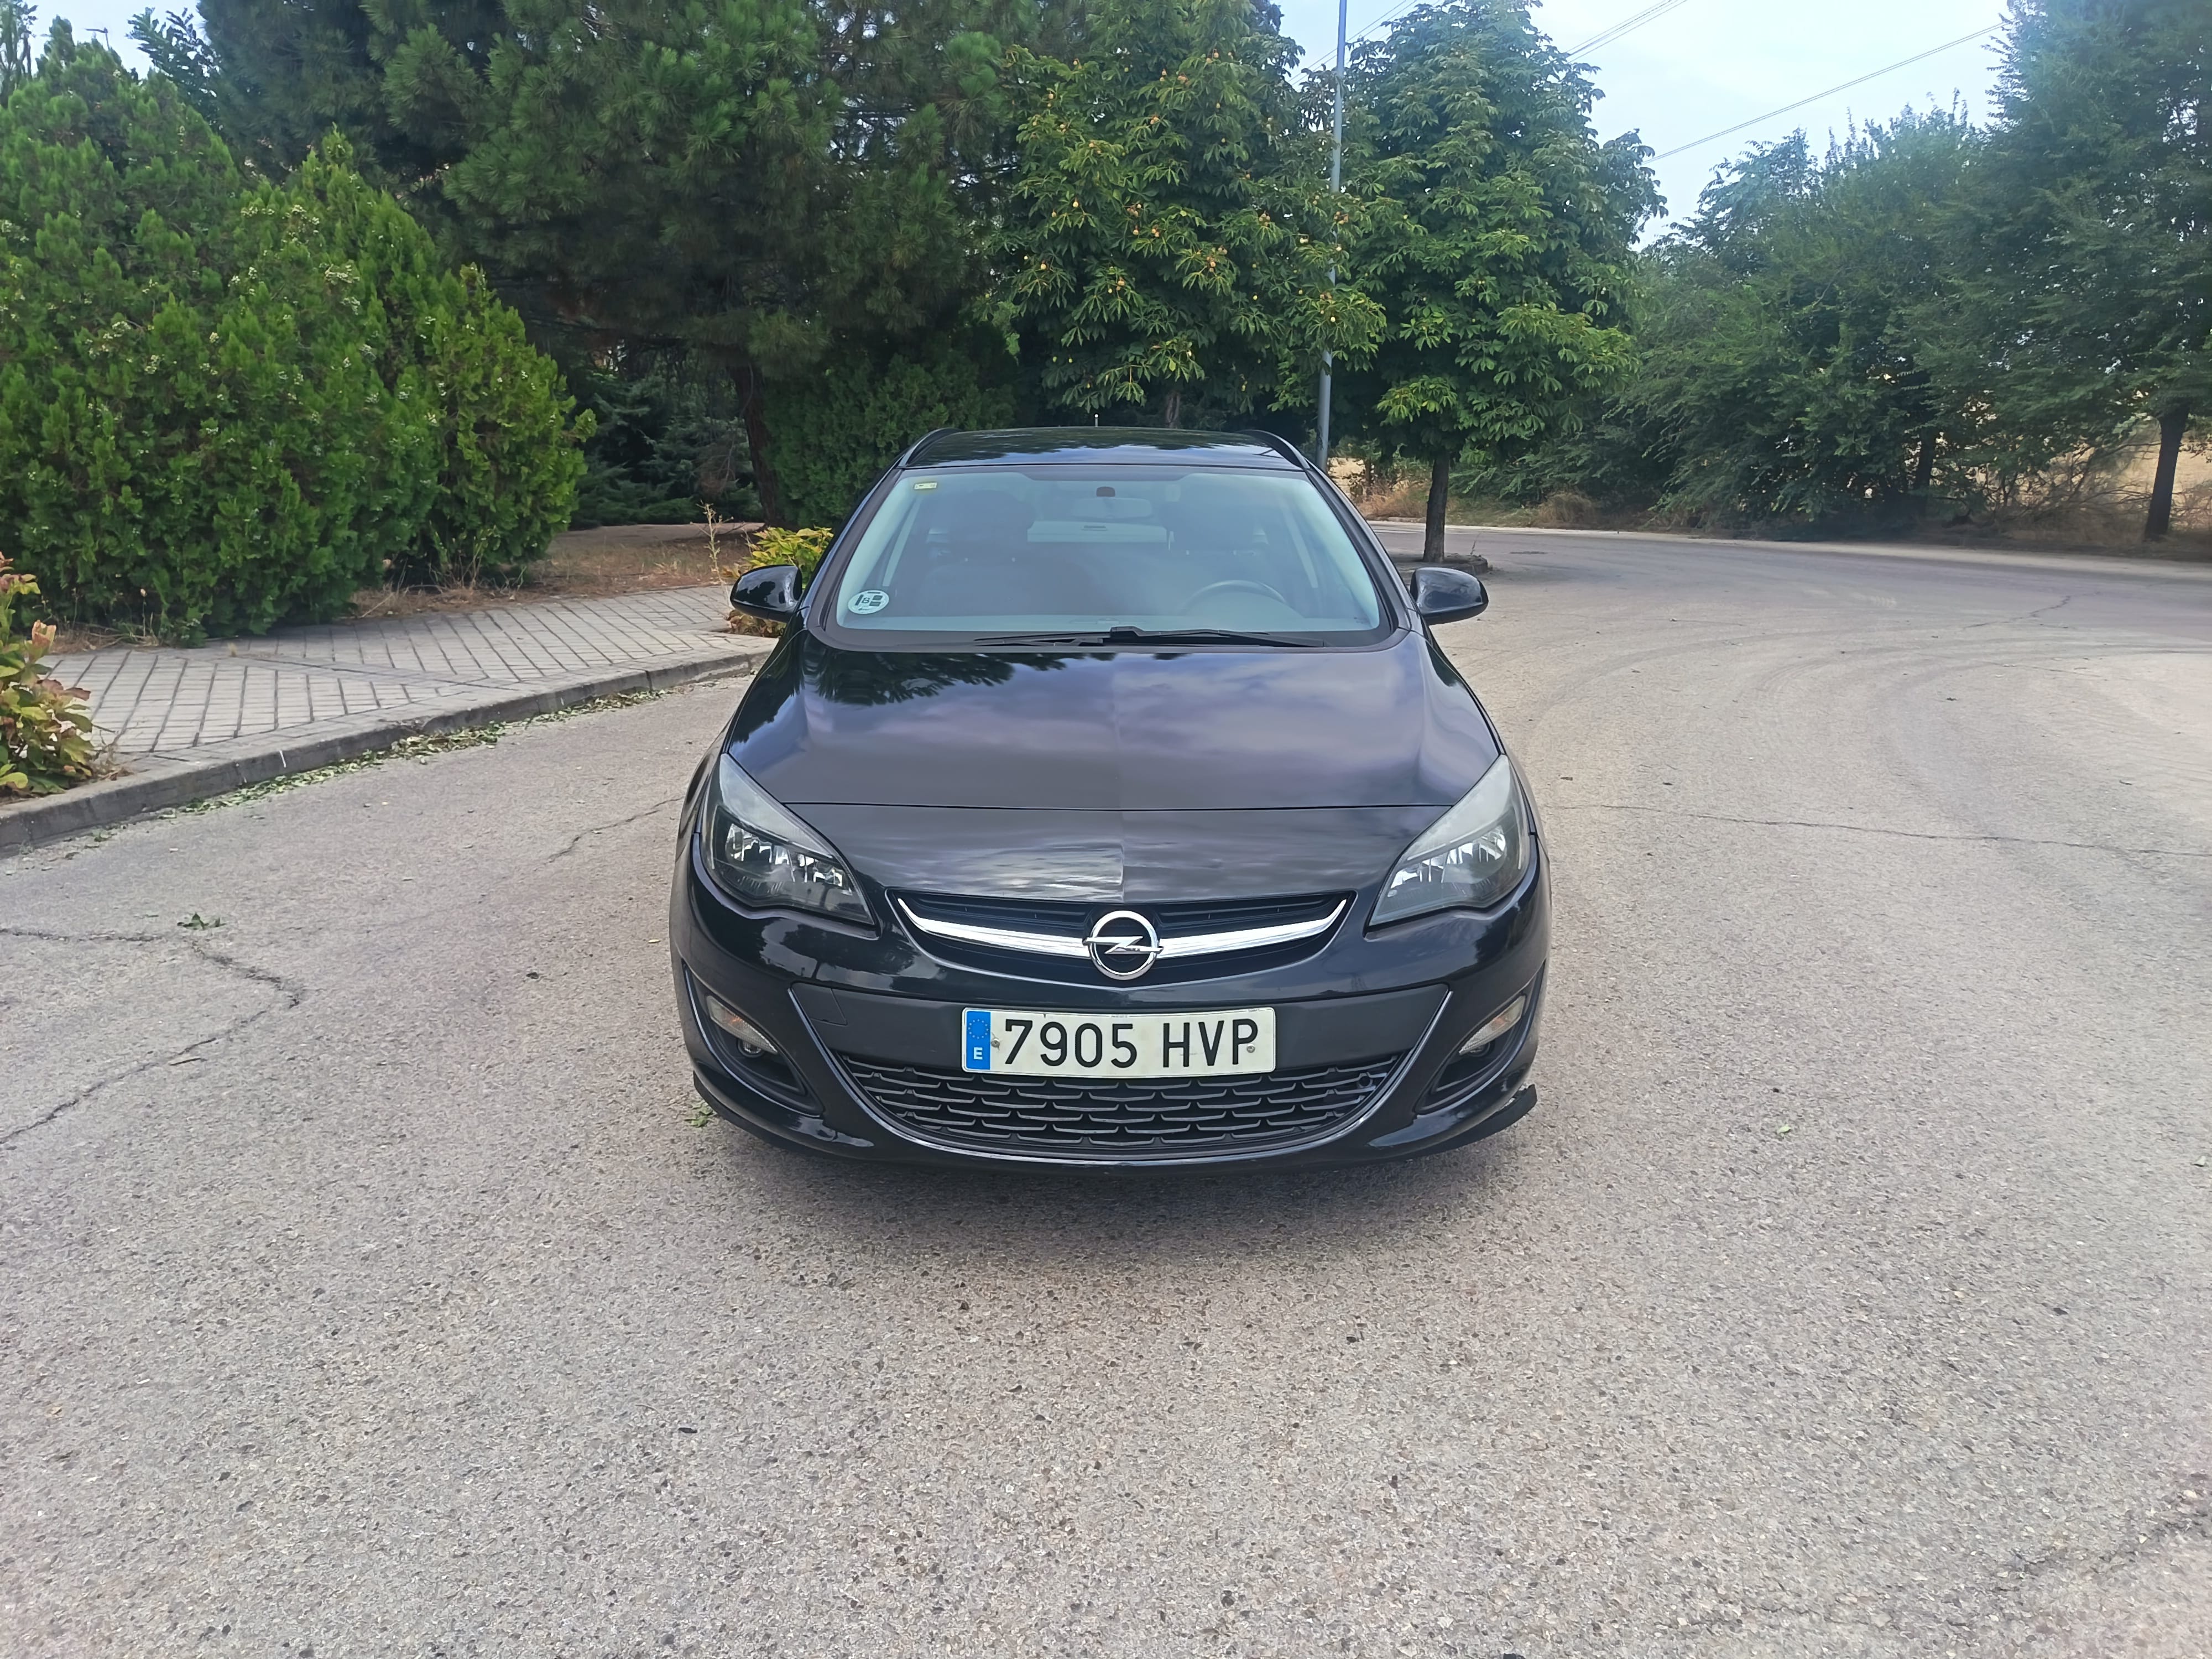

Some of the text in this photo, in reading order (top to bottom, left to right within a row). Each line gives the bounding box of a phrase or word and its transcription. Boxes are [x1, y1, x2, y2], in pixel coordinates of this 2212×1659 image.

[973, 1047, 983, 1060] E
[1005, 1018, 1258, 1068] 7905 HVP
